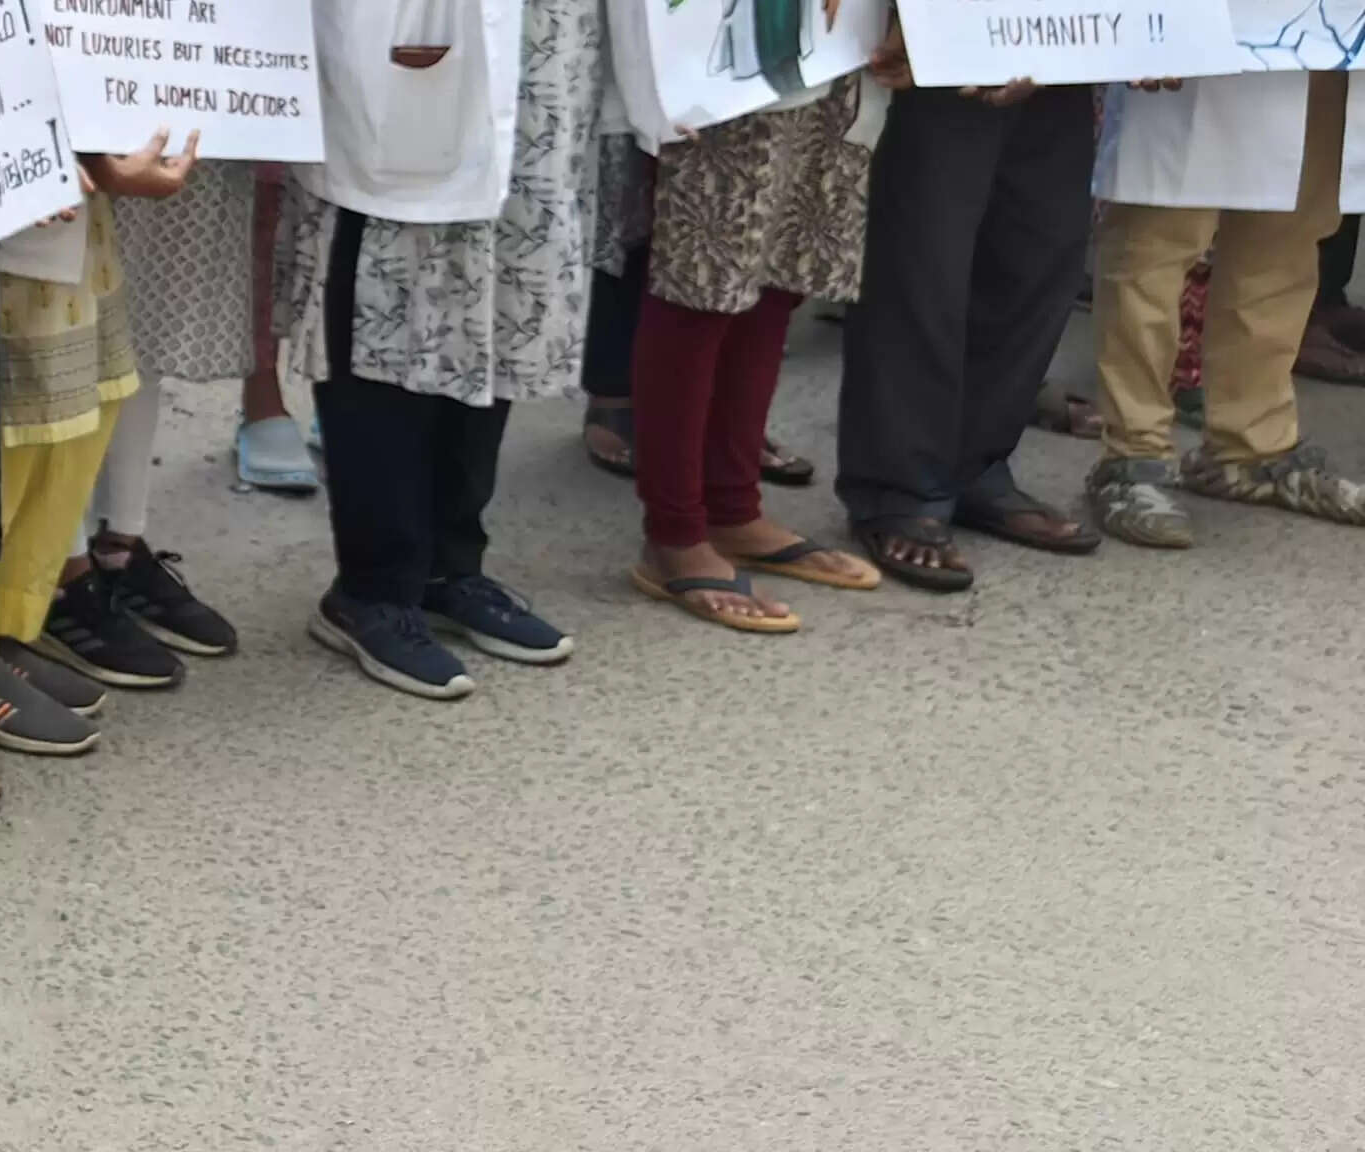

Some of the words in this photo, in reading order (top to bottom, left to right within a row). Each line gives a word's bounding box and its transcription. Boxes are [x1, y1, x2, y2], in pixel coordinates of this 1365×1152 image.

[44, 23, 74, 48] NOT
[81, 31, 162, 61] LUXURIES
[172, 41, 203, 62] BUT
[986, 12, 1123, 48] HUMANITY
[105, 77, 139, 107] FOR
[154, 83, 218, 113] WOMEN
[226, 88, 301, 119] DOCTORS
